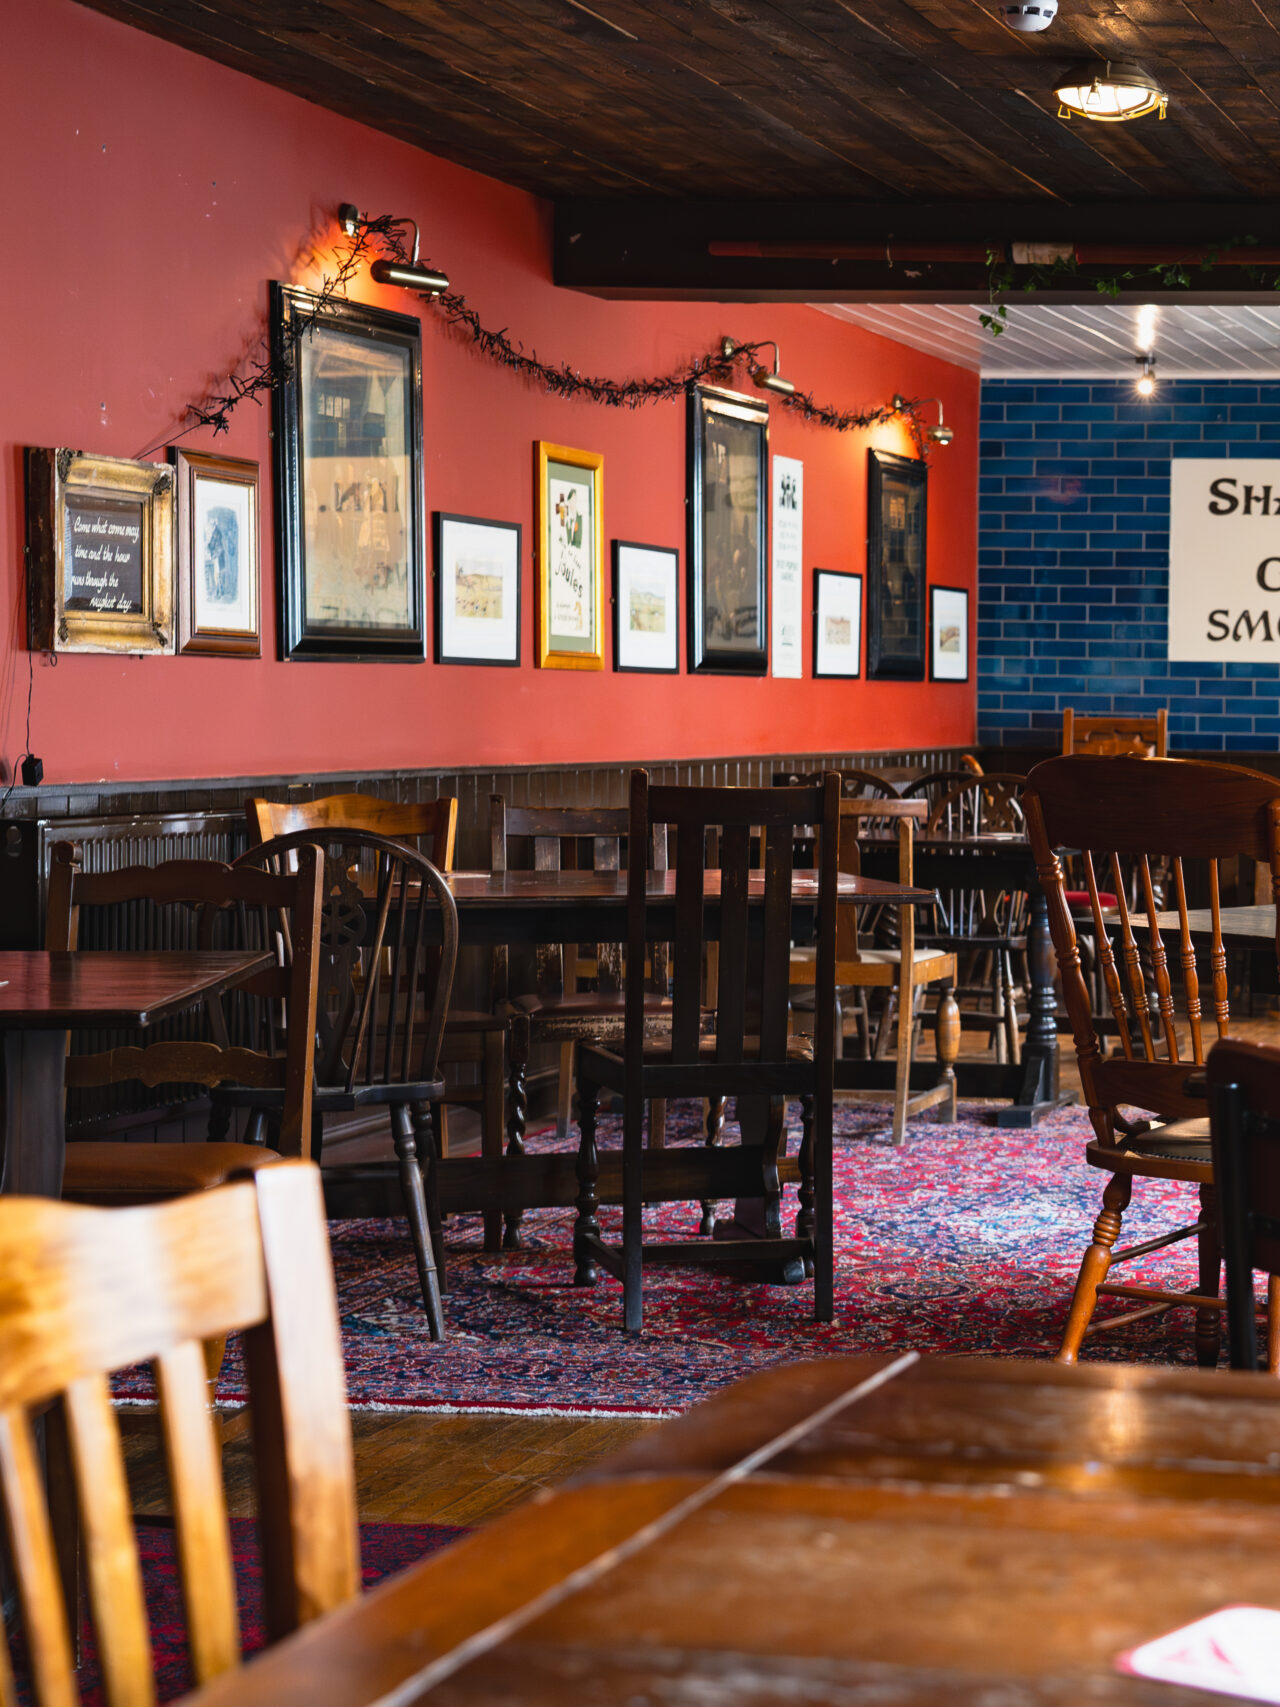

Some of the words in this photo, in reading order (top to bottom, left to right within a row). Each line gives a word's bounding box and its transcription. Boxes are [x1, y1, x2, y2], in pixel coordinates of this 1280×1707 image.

[74, 516, 91, 533] Come
[92, 517, 108, 533] what
[108, 524, 125, 536] come
[75, 545, 88, 558] time
[88, 544, 103, 560] and
[103, 544, 113, 561] the
[115, 546, 130, 563] hour
[72, 575, 84, 586] runs
[85, 570, 108, 594] through
[109, 572, 119, 587] the
[89, 592, 116, 612] roughest
